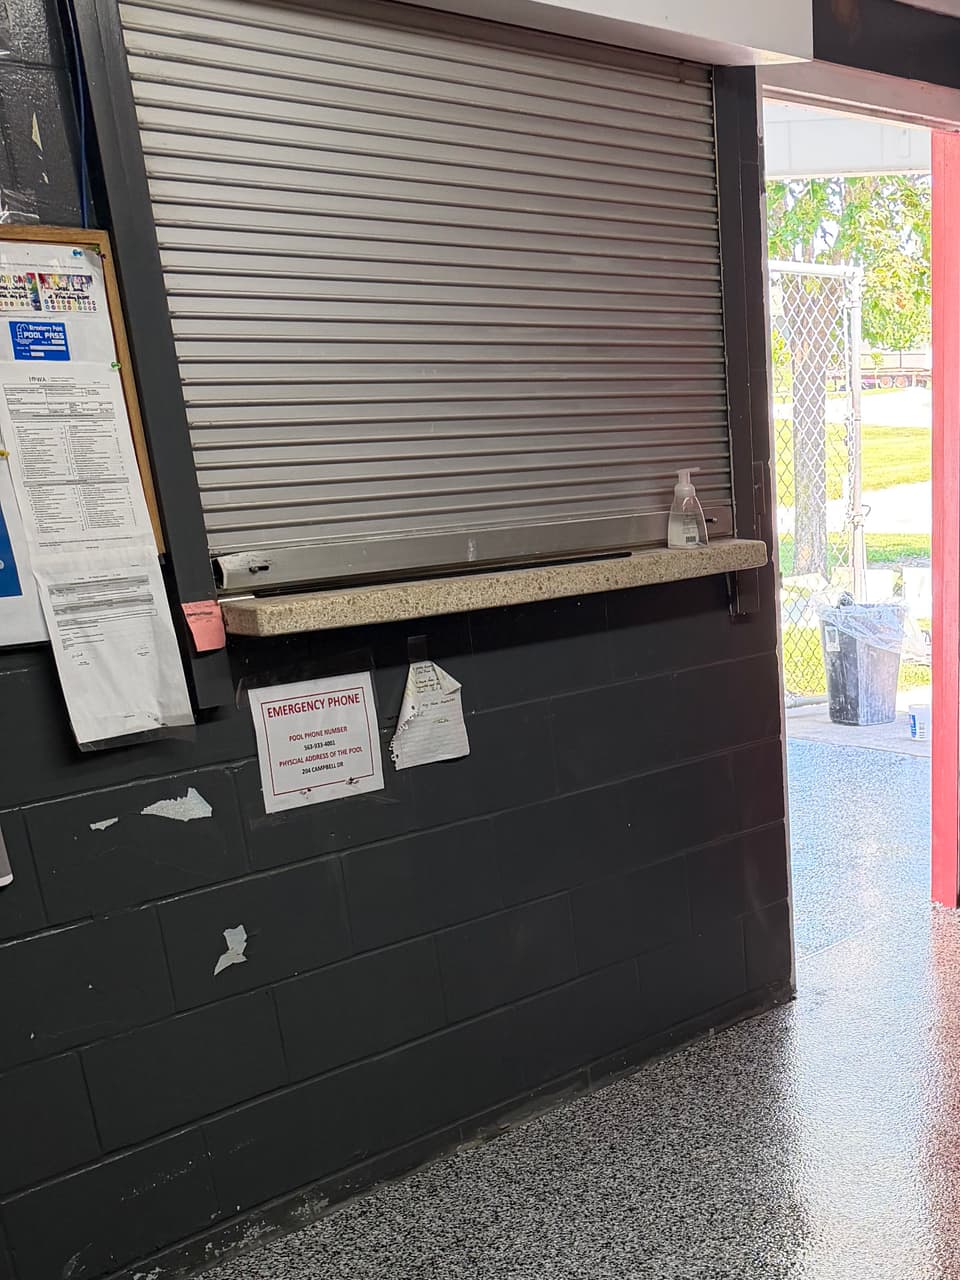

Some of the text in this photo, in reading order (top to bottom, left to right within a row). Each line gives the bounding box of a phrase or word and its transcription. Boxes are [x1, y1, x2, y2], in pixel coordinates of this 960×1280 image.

[267, 693, 360, 718] EMERGENCY PHONE
[289, 726, 348, 742] POOL PHONE NUMBER
[305, 753, 329, 762] ADDRESS
[329, 750, 337, 758] OF
[338, 748, 348, 757] THE
[348, 746, 363, 754] POOL
[311, 763, 336, 773] CAMPBELL
